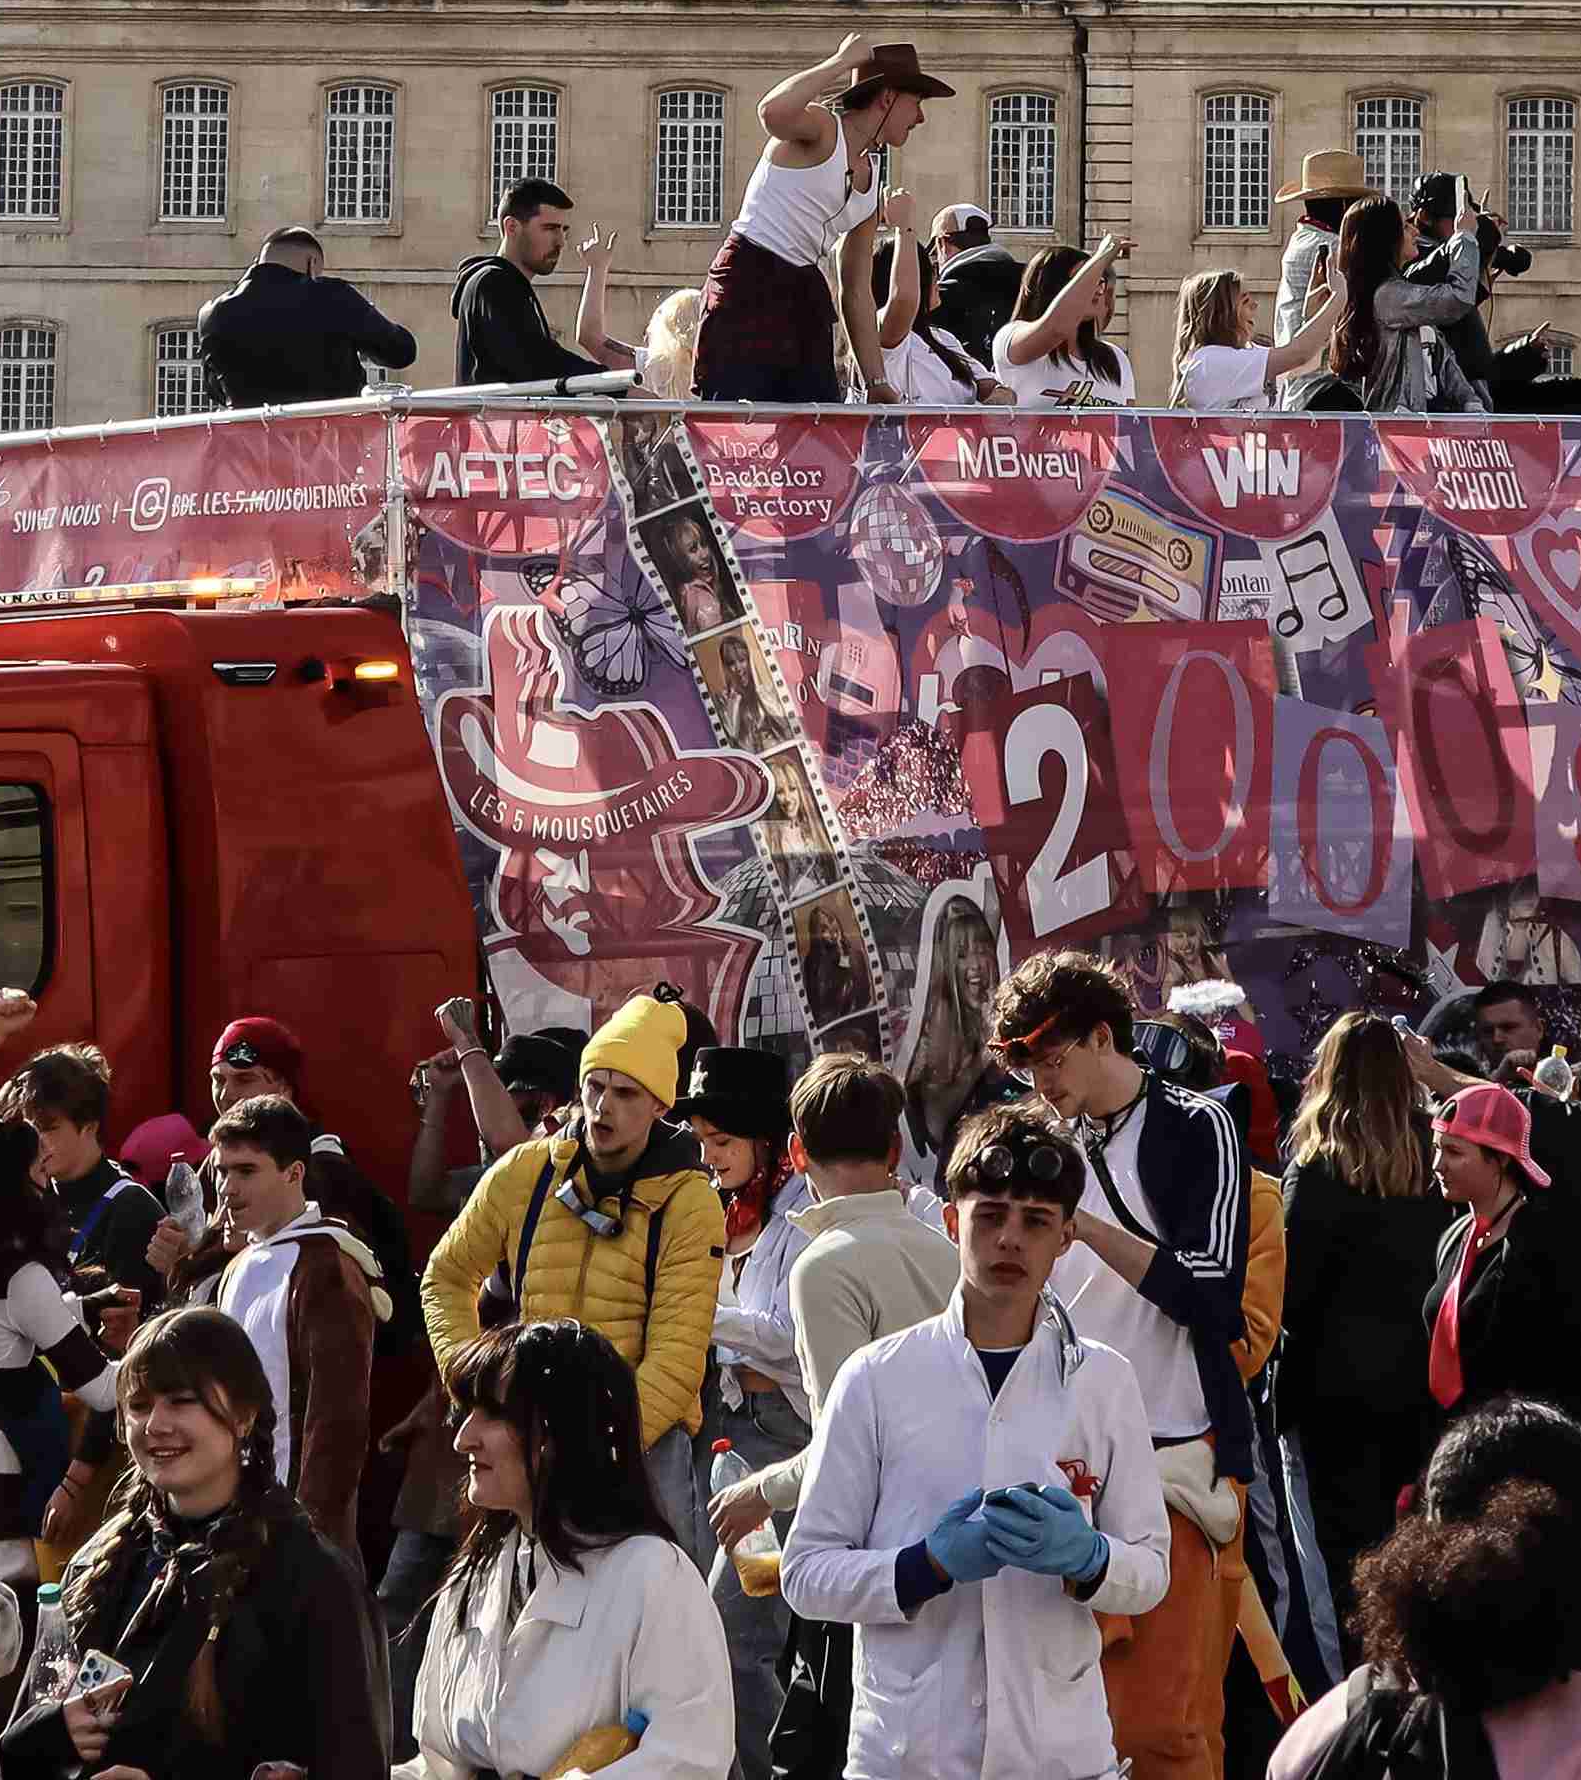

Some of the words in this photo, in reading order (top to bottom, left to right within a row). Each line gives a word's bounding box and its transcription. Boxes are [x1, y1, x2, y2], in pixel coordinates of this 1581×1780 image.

[426, 451, 582, 501] AFTEC
[705, 463, 822, 488] Bachelor
[957, 435, 1082, 491] MBway
[731, 492, 832, 523] Factory
[1436, 470, 1528, 511] SCHOOL
[60, 503, 102, 527] NOUS
[470, 785, 508, 825] LES
[512, 809, 526, 833] 5
[531, 769, 694, 842] MOUSQUETAIRES
